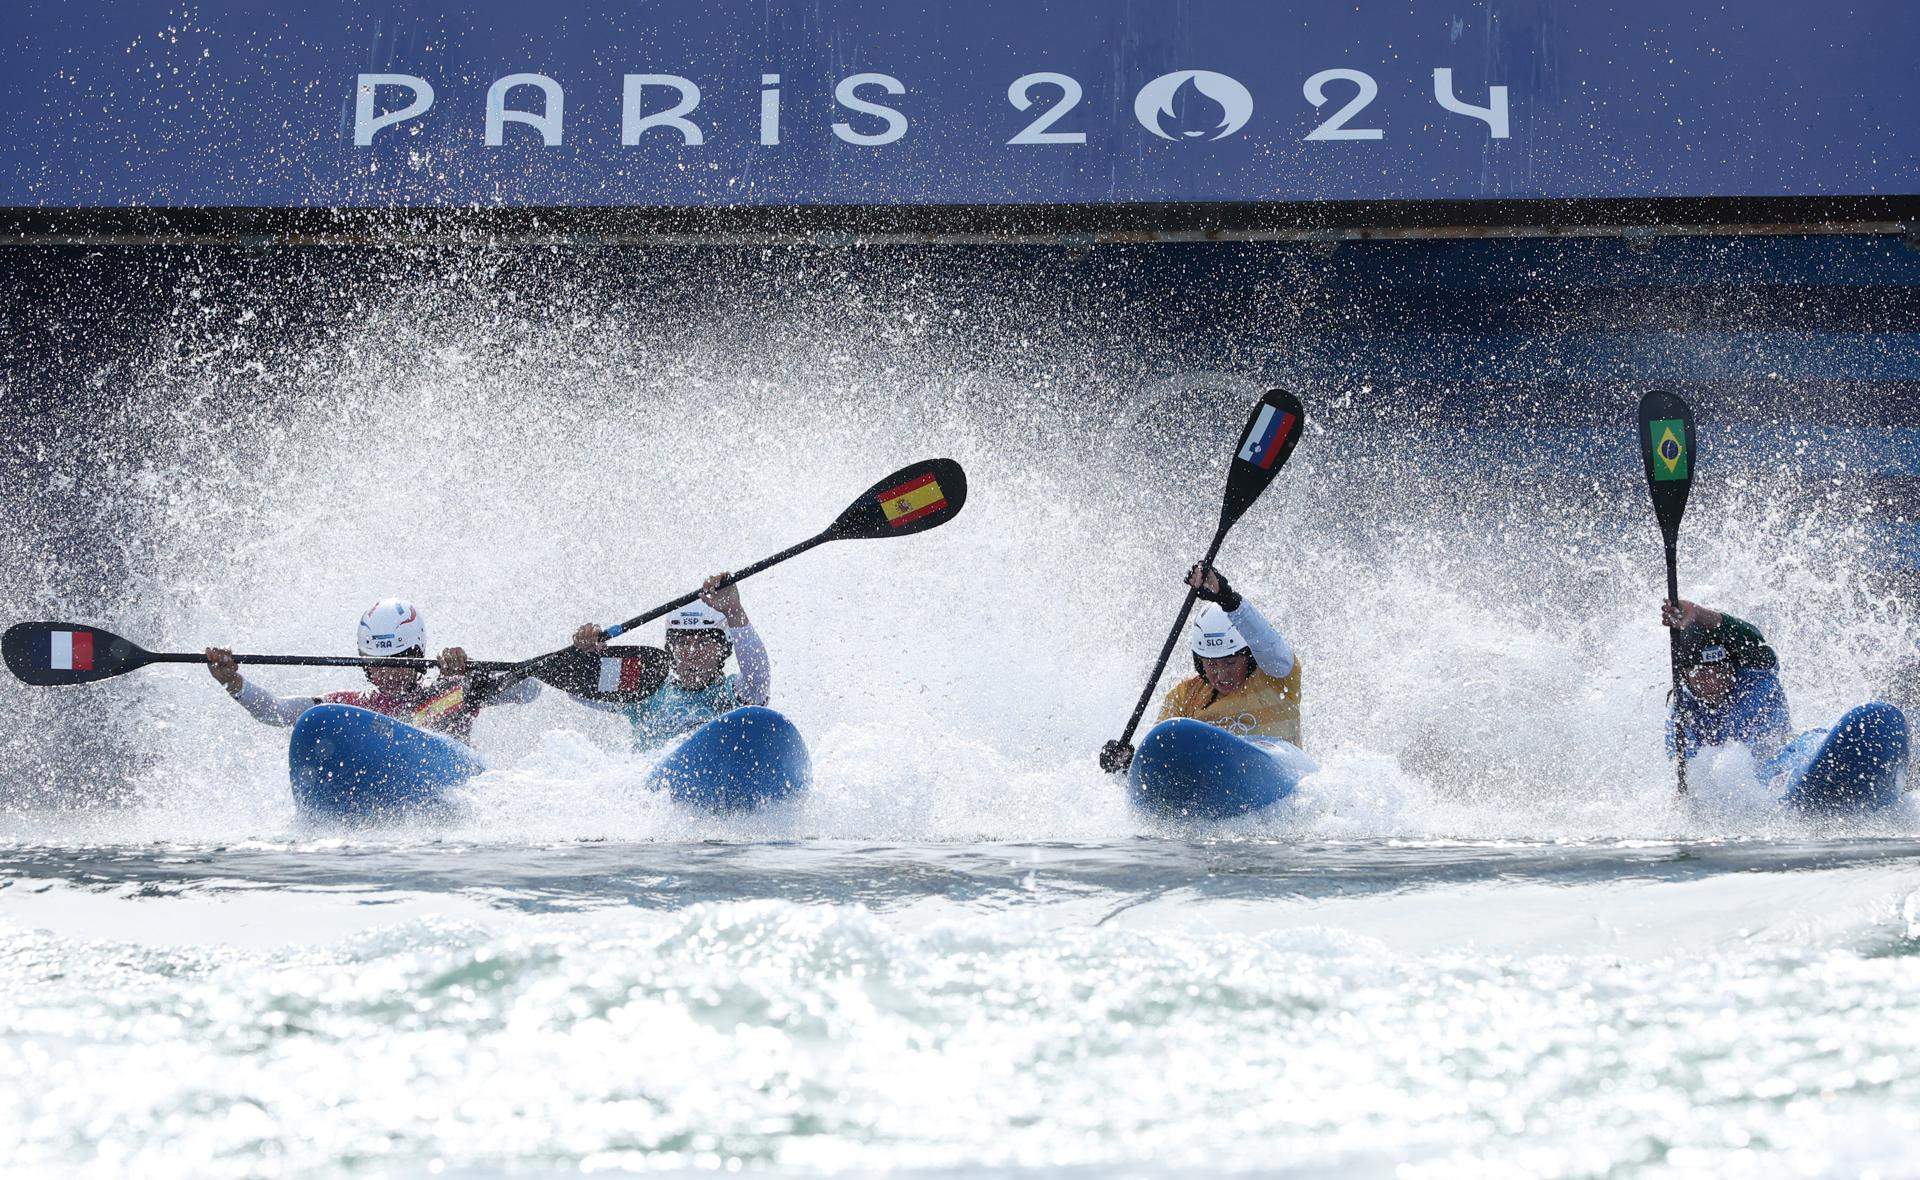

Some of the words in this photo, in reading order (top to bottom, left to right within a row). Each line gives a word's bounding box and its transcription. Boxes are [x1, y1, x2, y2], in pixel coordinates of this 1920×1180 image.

[1006, 68, 1510, 145] 2024
[375, 640, 392, 649] FRA
[1206, 639, 1223, 647] SLO
